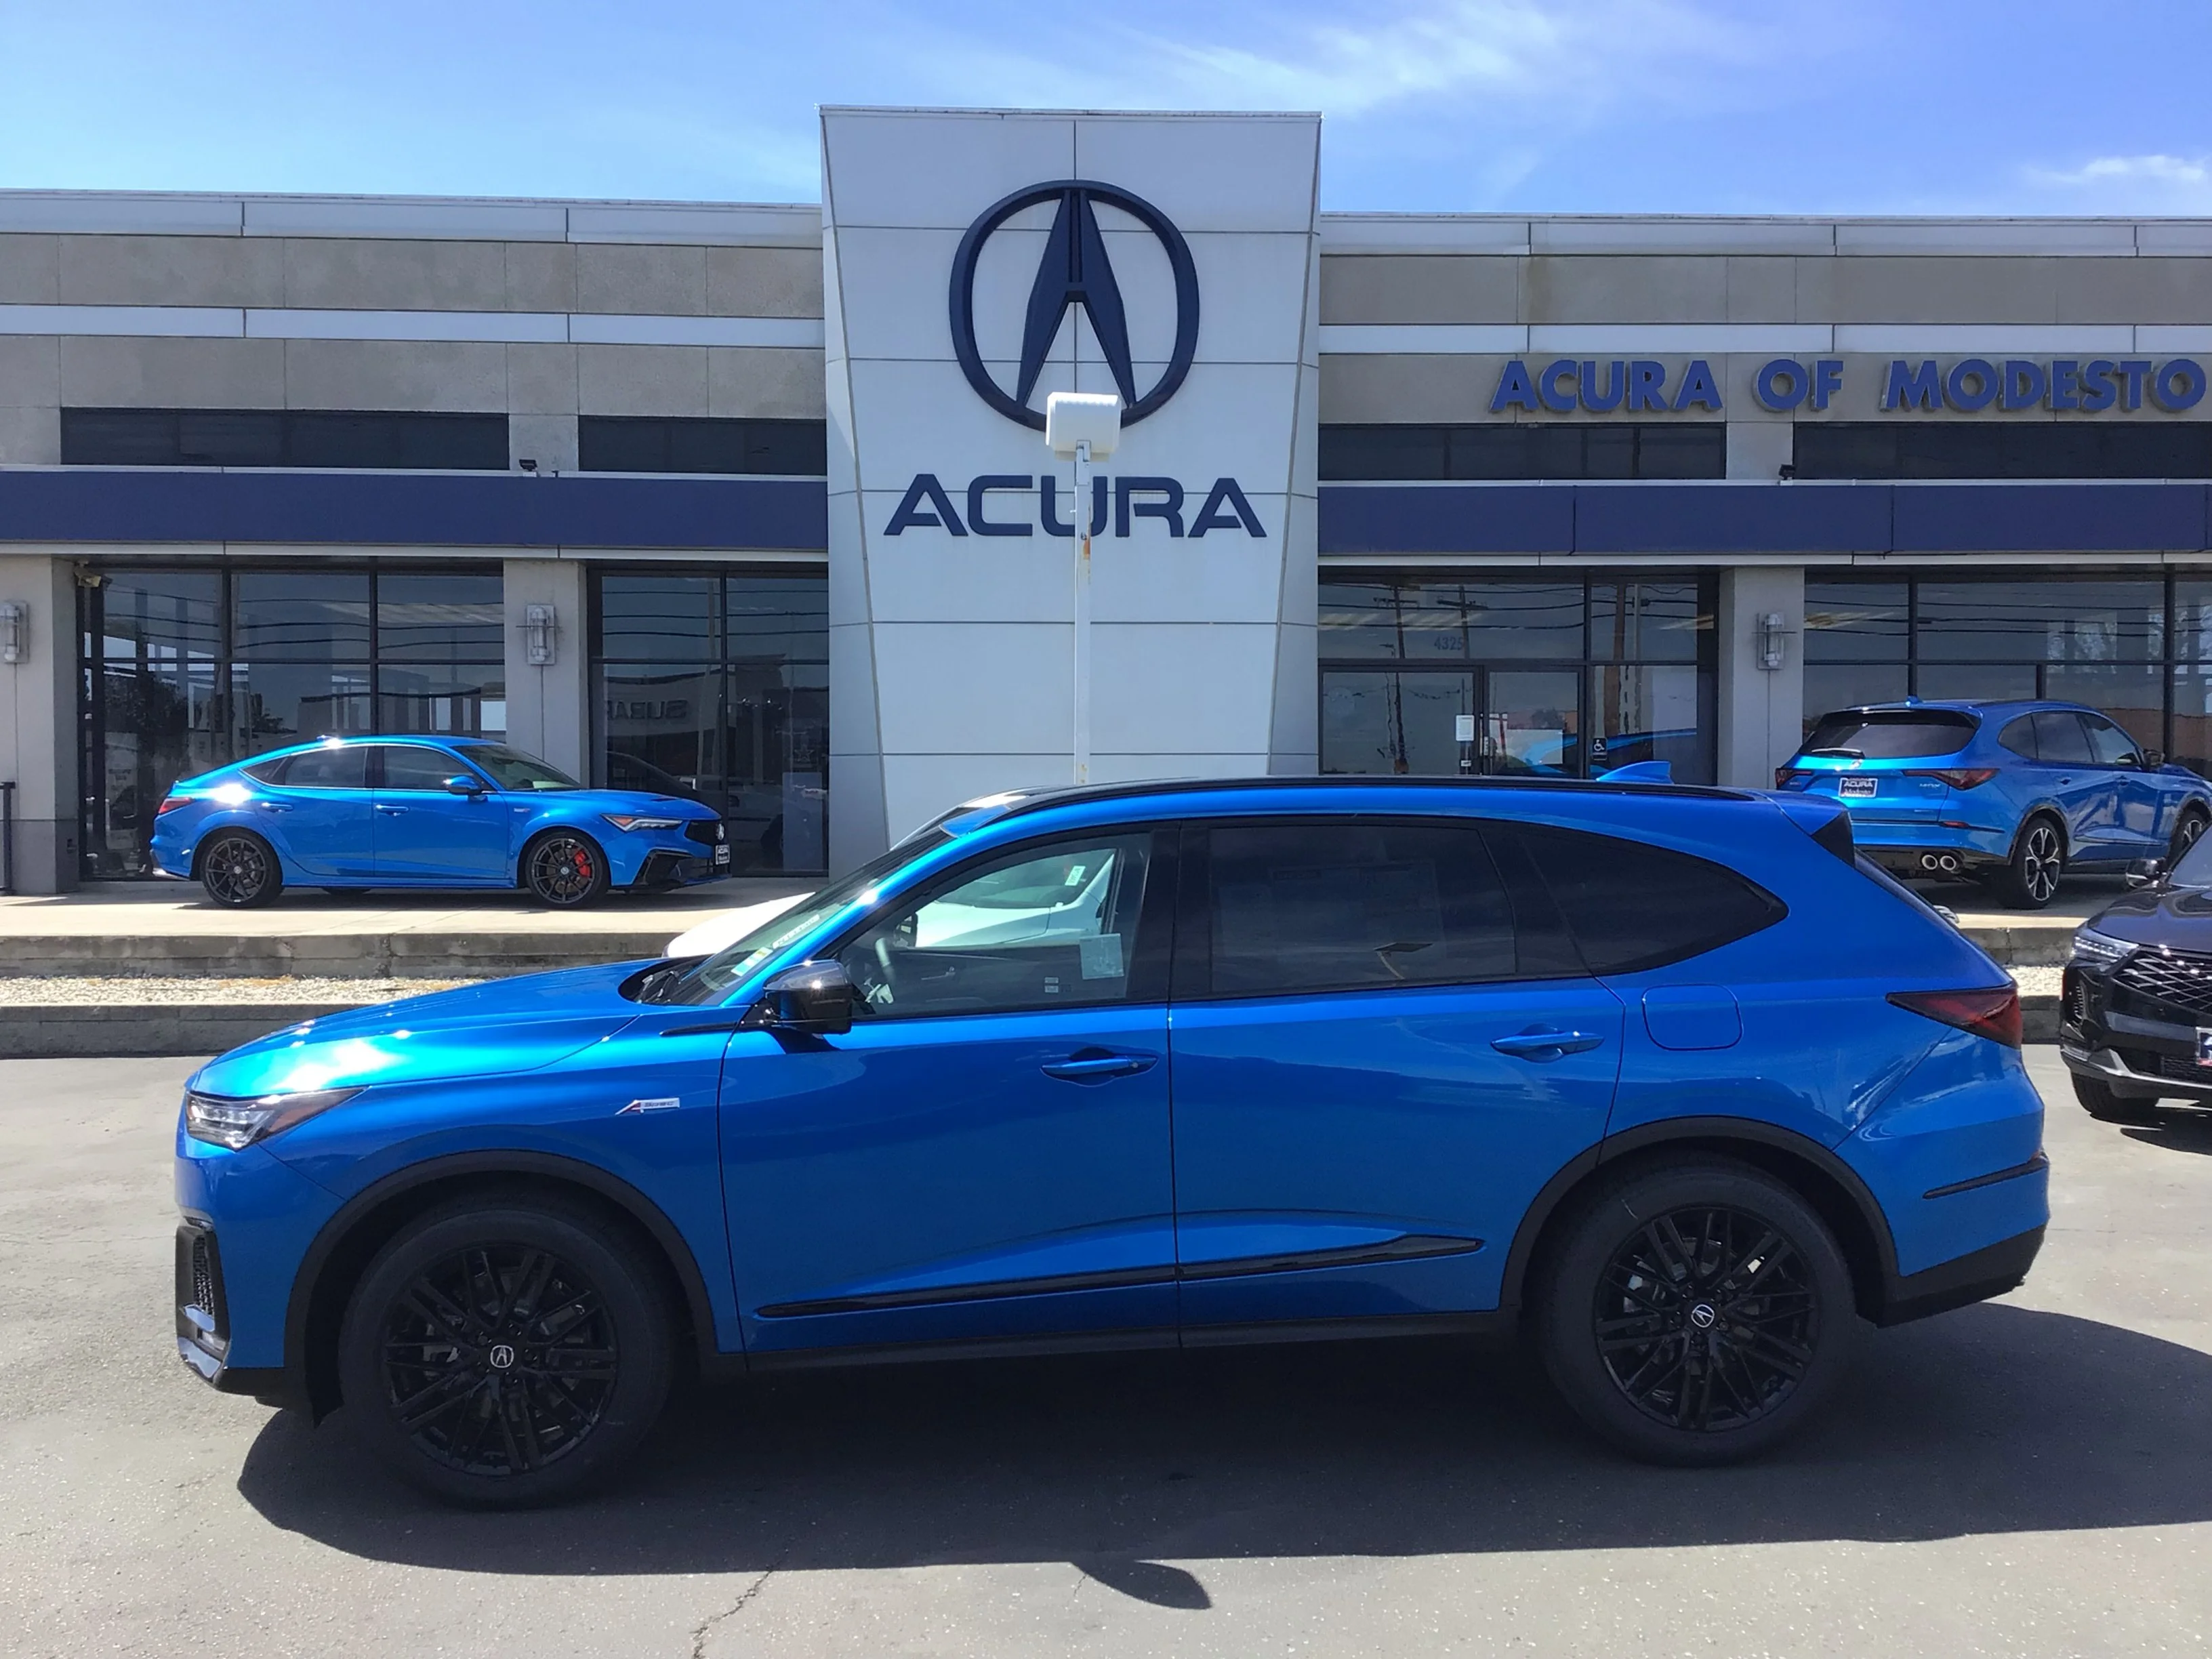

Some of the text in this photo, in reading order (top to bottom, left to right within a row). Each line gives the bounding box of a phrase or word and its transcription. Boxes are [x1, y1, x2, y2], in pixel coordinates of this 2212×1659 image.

[1490, 359, 2207, 411] ACURA OF MODESTO
[883, 473, 1267, 537] ACURA
